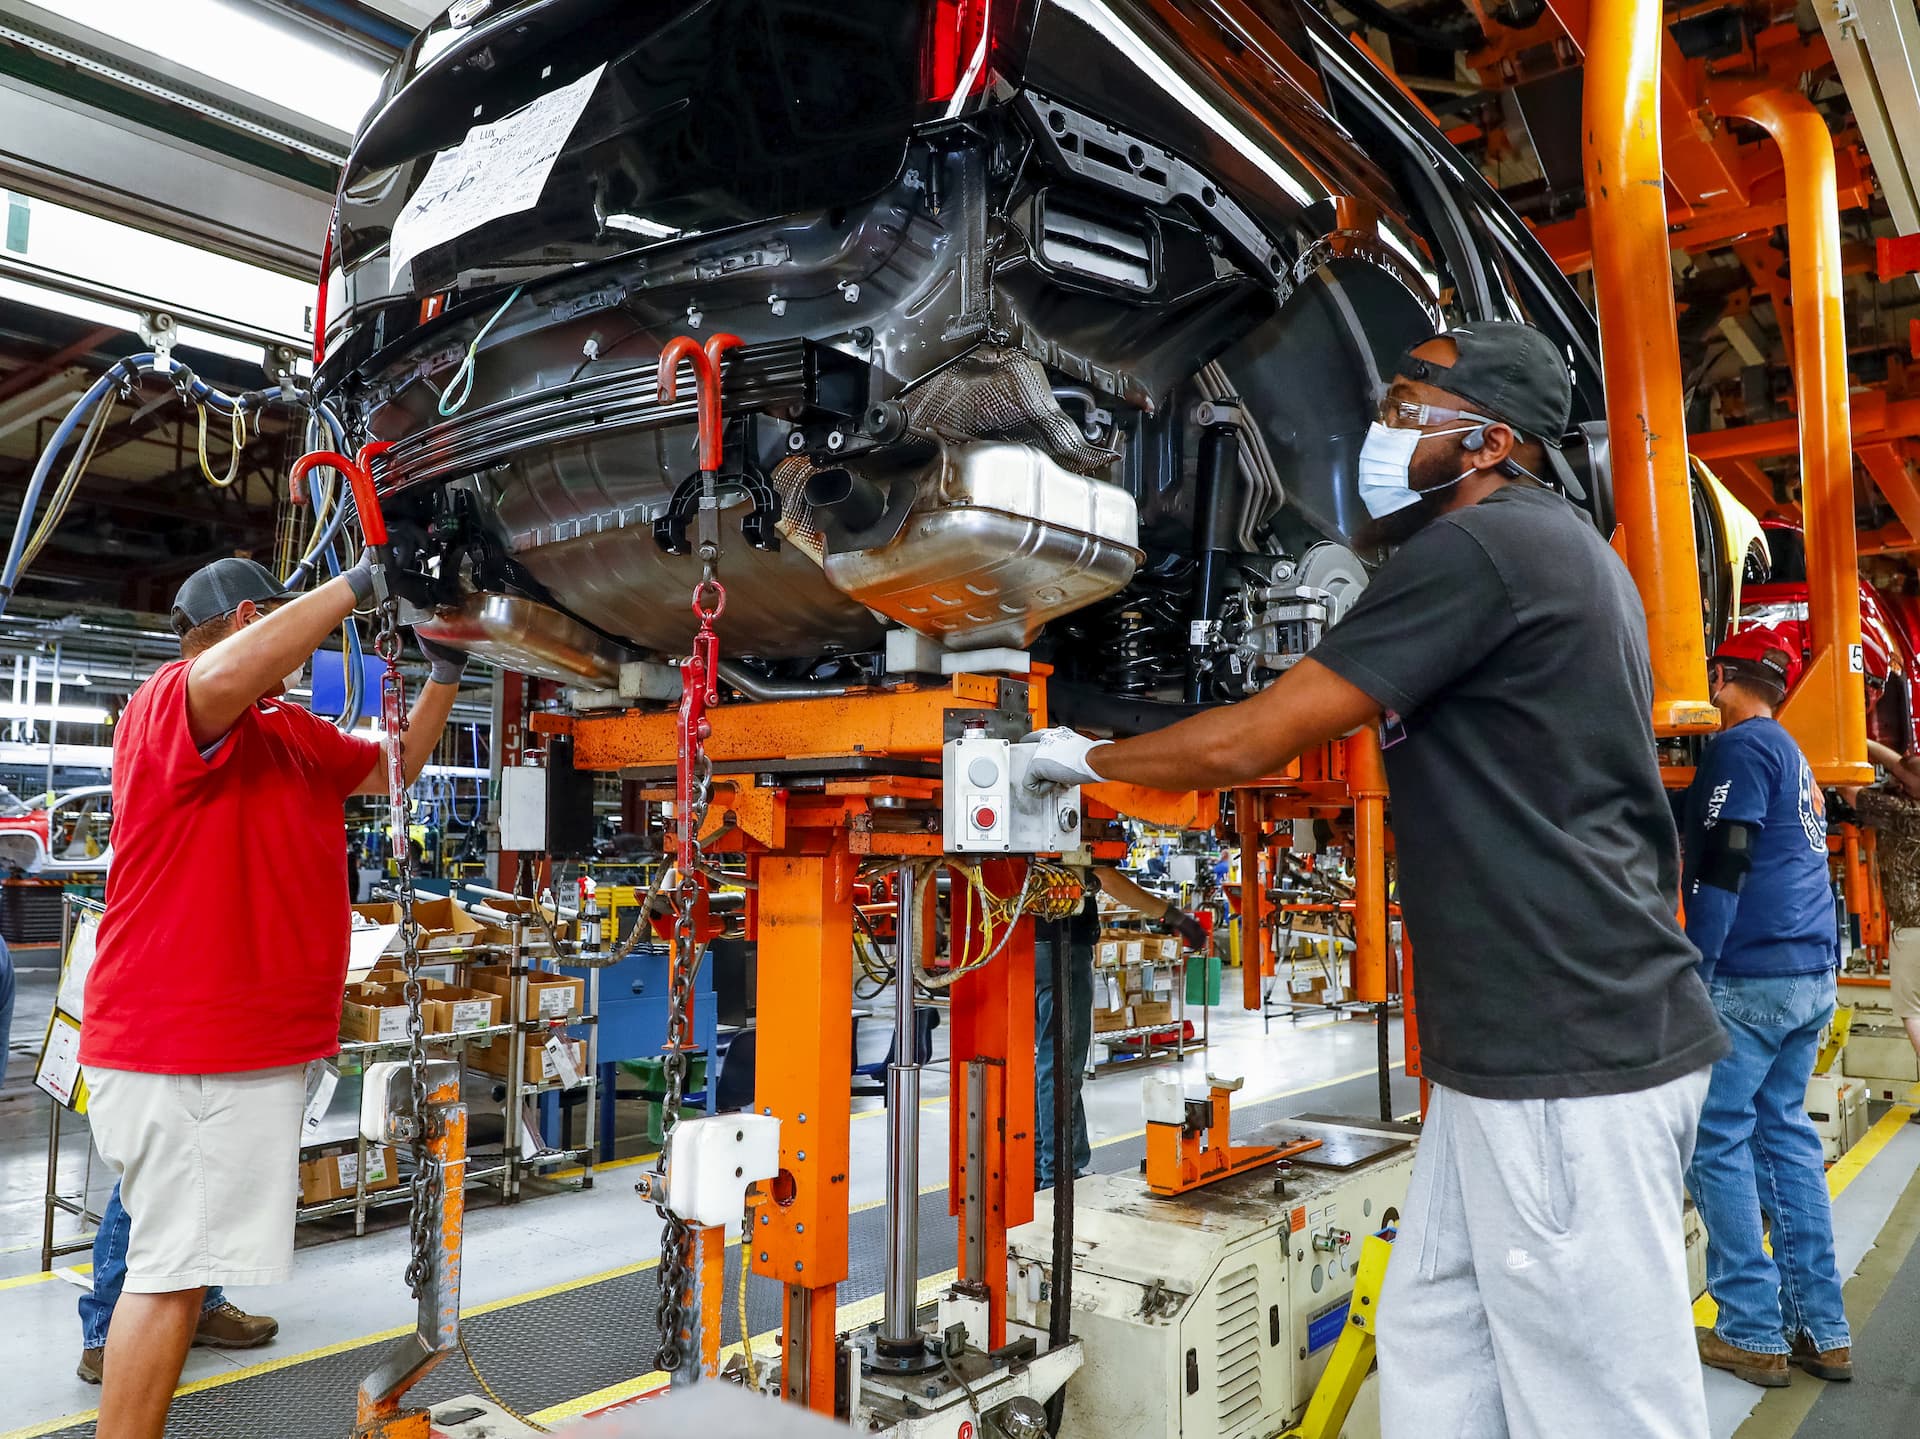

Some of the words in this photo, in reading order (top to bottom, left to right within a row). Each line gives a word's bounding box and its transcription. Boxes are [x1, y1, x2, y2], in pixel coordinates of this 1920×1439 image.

[480, 128, 496, 140] LUX
[1852, 645, 1863, 671] 5
[561, 882, 575, 891] ONE
[1505, 1247, 1529, 1265] NIKE
